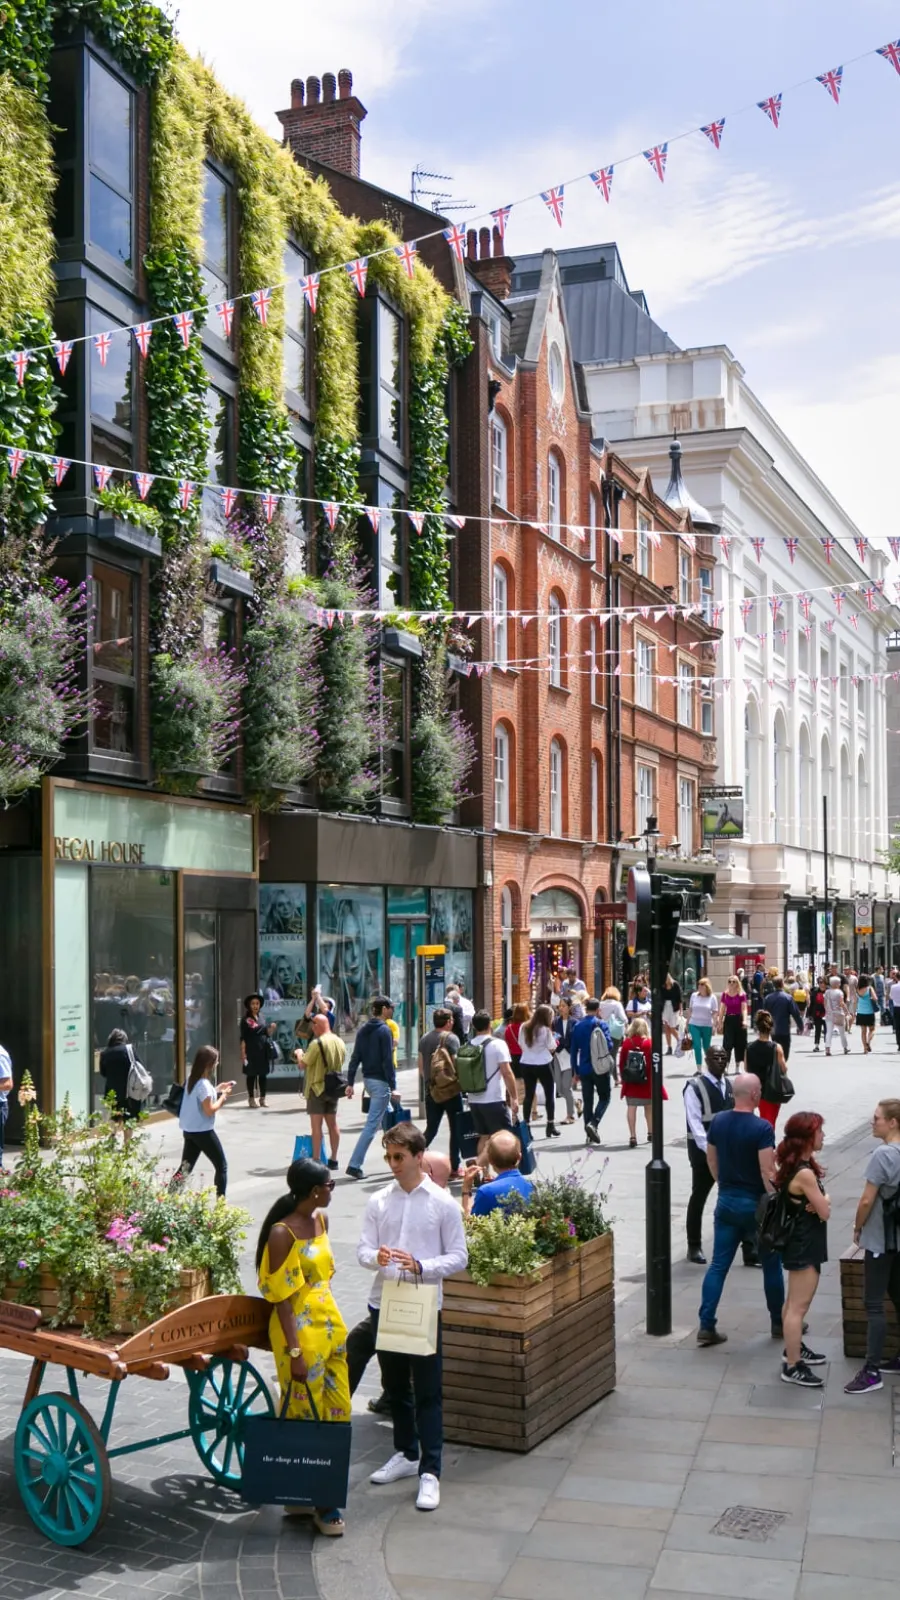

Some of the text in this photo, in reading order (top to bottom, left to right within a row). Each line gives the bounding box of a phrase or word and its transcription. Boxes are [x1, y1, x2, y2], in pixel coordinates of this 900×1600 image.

[54, 836, 146, 865] REGAL HOUSE
[161, 1319, 214, 1342] COVENT
[275, 1456, 291, 1465] shop
[302, 1457, 331, 1466] bluebird
